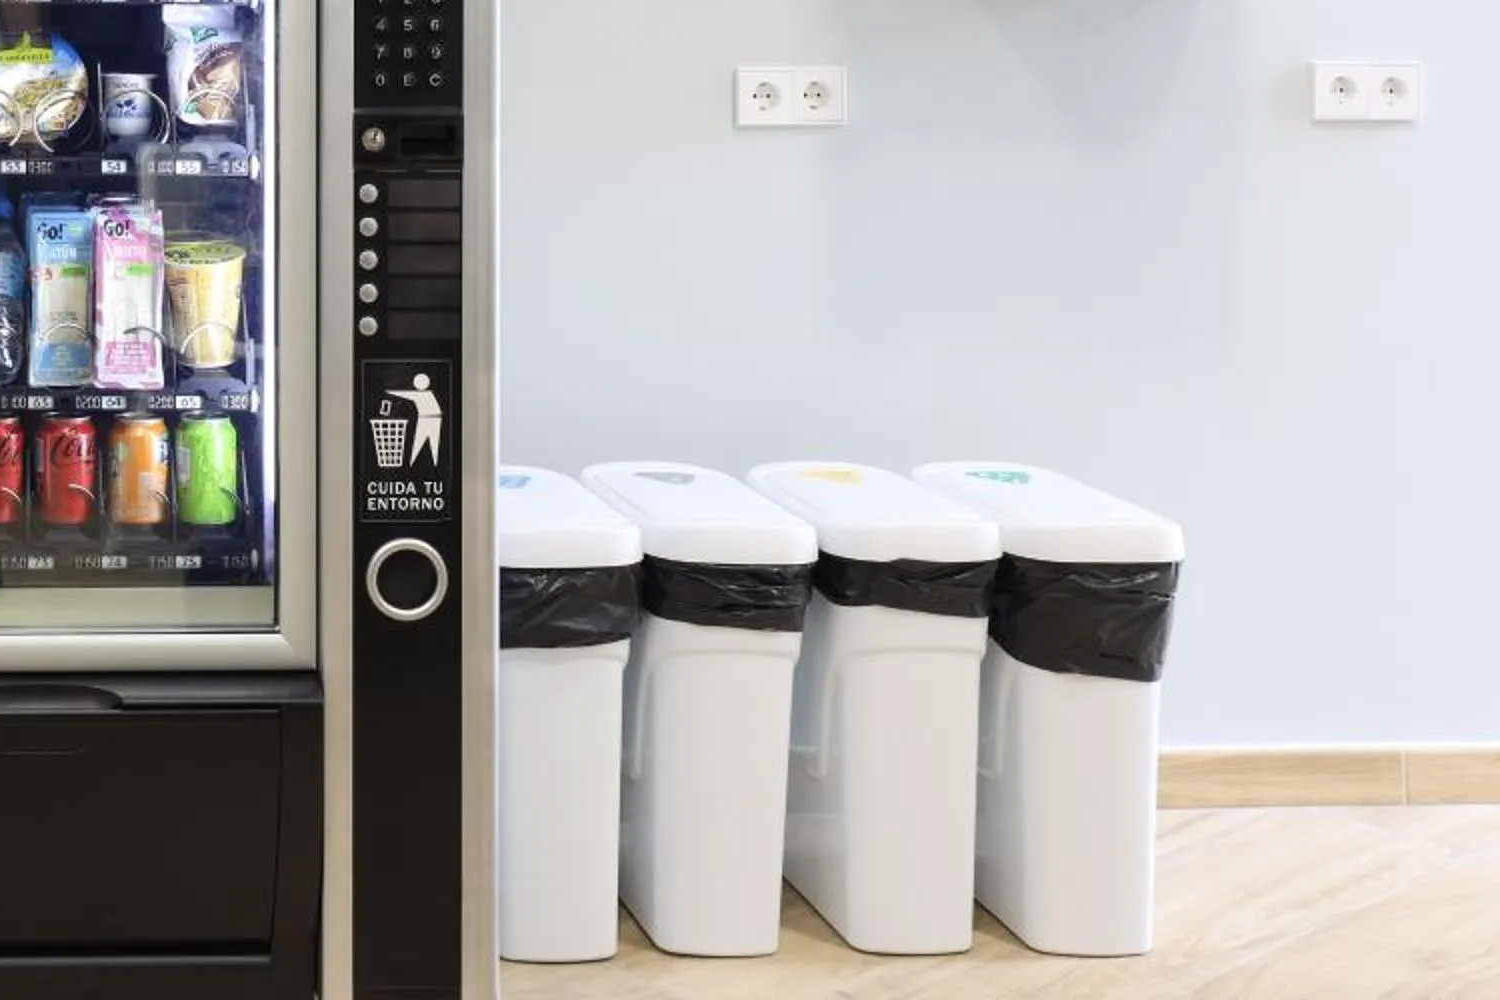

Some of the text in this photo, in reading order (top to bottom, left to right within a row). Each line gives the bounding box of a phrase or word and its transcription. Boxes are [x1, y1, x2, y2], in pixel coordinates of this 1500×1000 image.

[403, 19, 413, 31] 5
[103, 219, 131, 238] Go!
[367, 480, 443, 495] CUIDA TU
[367, 497, 445, 511] ENTORNO
